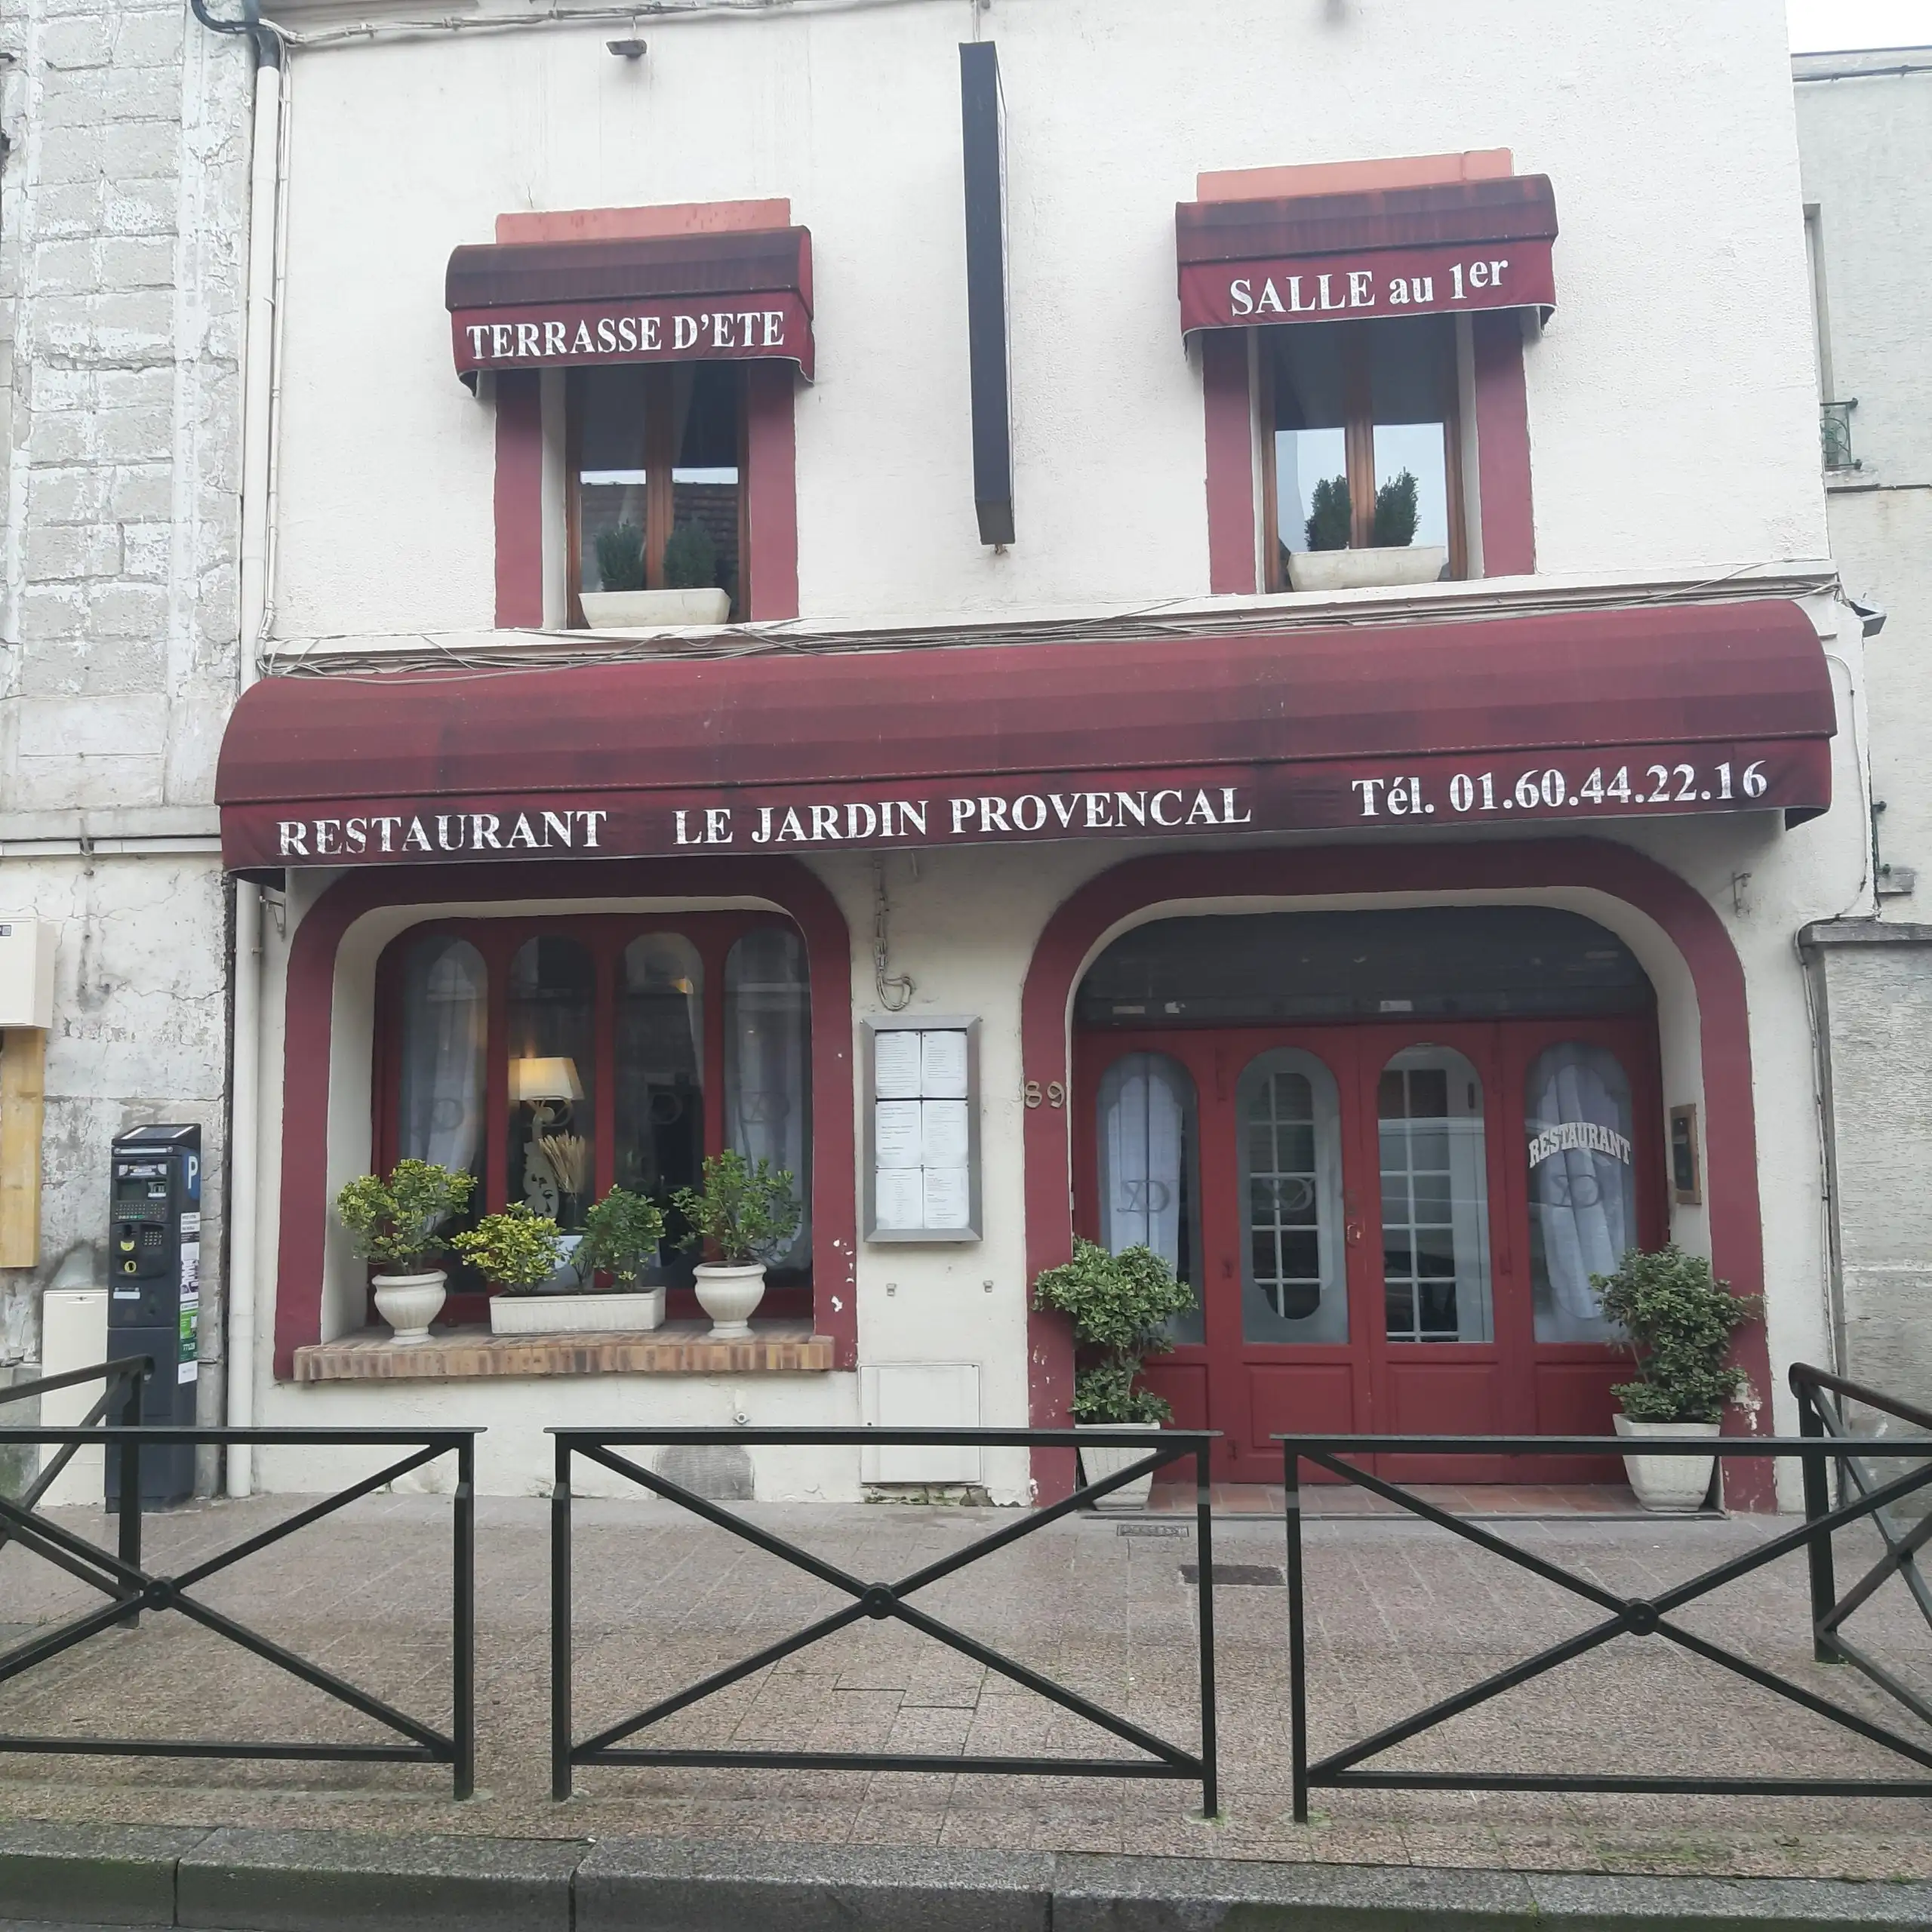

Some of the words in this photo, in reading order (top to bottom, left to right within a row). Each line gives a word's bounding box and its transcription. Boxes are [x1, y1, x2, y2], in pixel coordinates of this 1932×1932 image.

[1231, 270, 1376, 316] SALLE
[1389, 277, 1434, 304] au
[1449, 260, 1509, 300] 1er
[466, 317, 662, 359] TERRASSE
[672, 312, 785, 349] D'ETE
[276, 811, 607, 856] RESTAURANT
[672, 808, 734, 844] LE
[751, 800, 929, 843] JARDIN
[948, 787, 1251, 834] PROVENCAL
[1352, 777, 1435, 816] Tél.
[1449, 760, 1767, 812] 01.60.44.22.16
[1528, 1121, 1631, 1168] RESTAURANT
[188, 1155, 198, 1189] P
